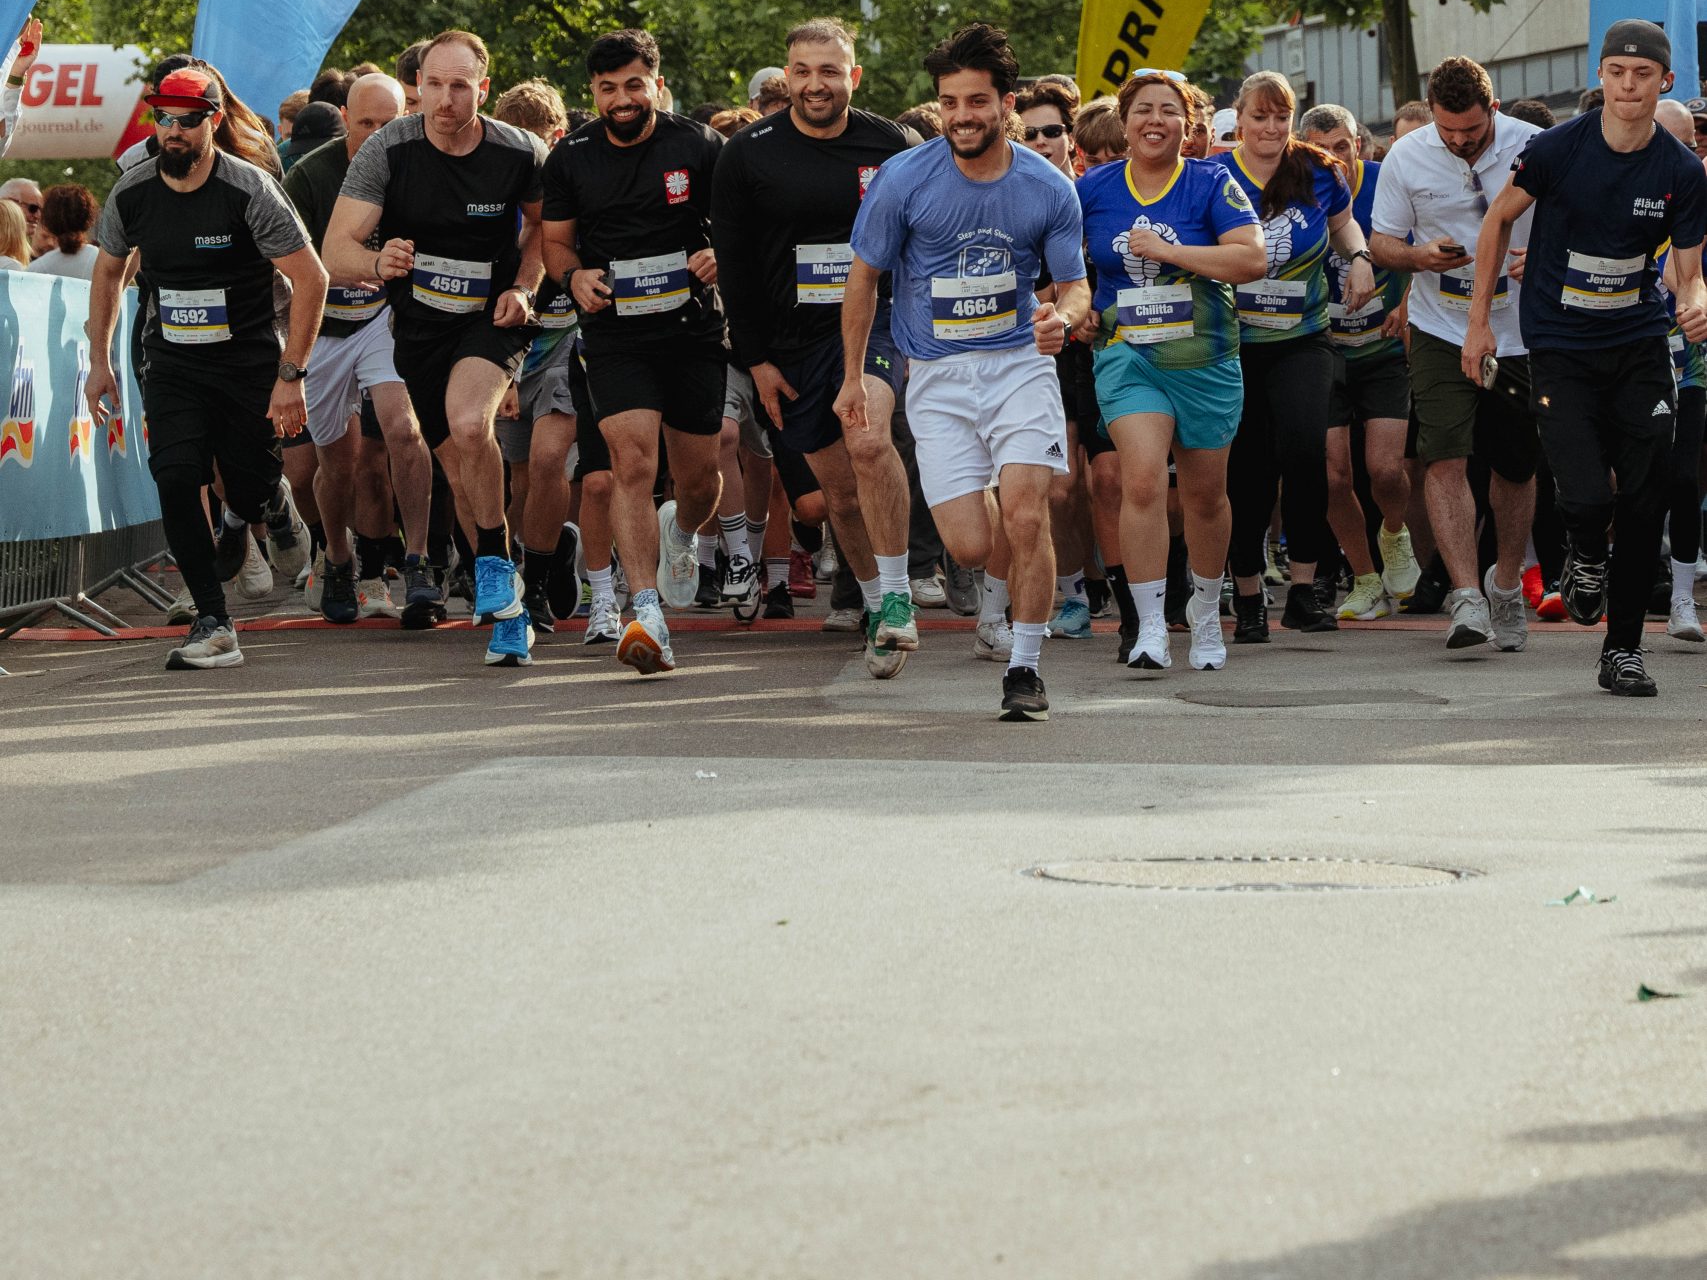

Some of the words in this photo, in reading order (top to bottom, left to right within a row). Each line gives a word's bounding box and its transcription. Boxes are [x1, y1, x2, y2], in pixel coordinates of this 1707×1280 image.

[466, 203, 506, 213] massar
[1634, 198, 1665, 210] #läuft
[1633, 208, 1647, 216] bei
[1648, 210, 1664, 218] uns
[194, 234, 232, 245] massar
[957, 231, 975, 241] Steps
[994, 229, 1013, 243] Stories
[430, 275, 470, 295] 4591
[634, 275, 669, 288] Adnan
[1586, 274, 1626, 286] Jeremy
[1254, 294, 1288, 306] Sabine
[952, 297, 998, 317] 4664
[1135, 304, 1174, 316] Chilitta
[170, 309, 208, 324] 4592
